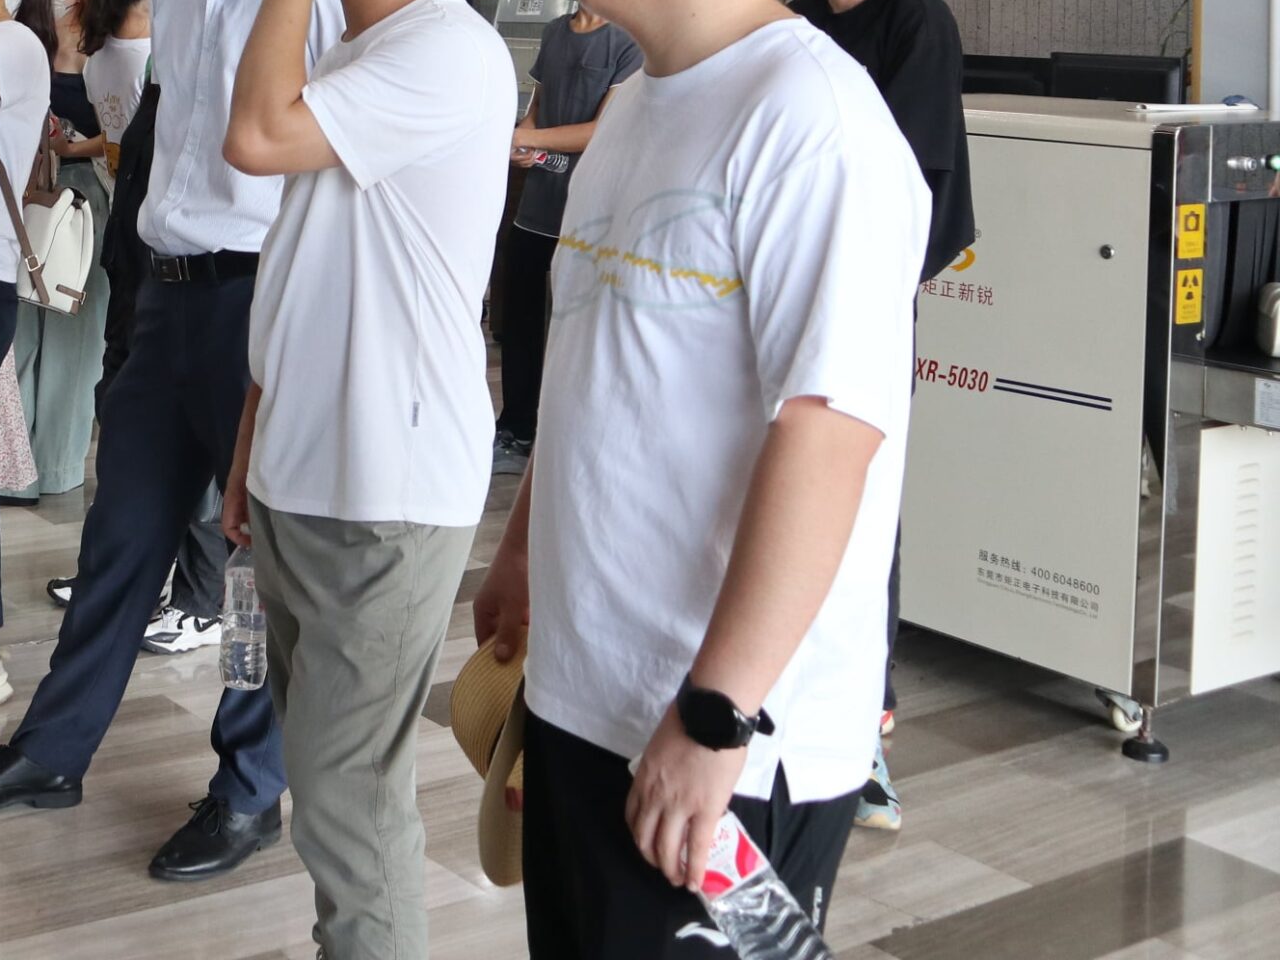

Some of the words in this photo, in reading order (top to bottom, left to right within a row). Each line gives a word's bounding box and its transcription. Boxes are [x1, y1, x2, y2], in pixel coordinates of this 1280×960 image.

[922, 279, 994, 306] 矩正新锐
[1030, 566, 1051, 581] 400
[1052, 572, 1101, 596] 6048600
